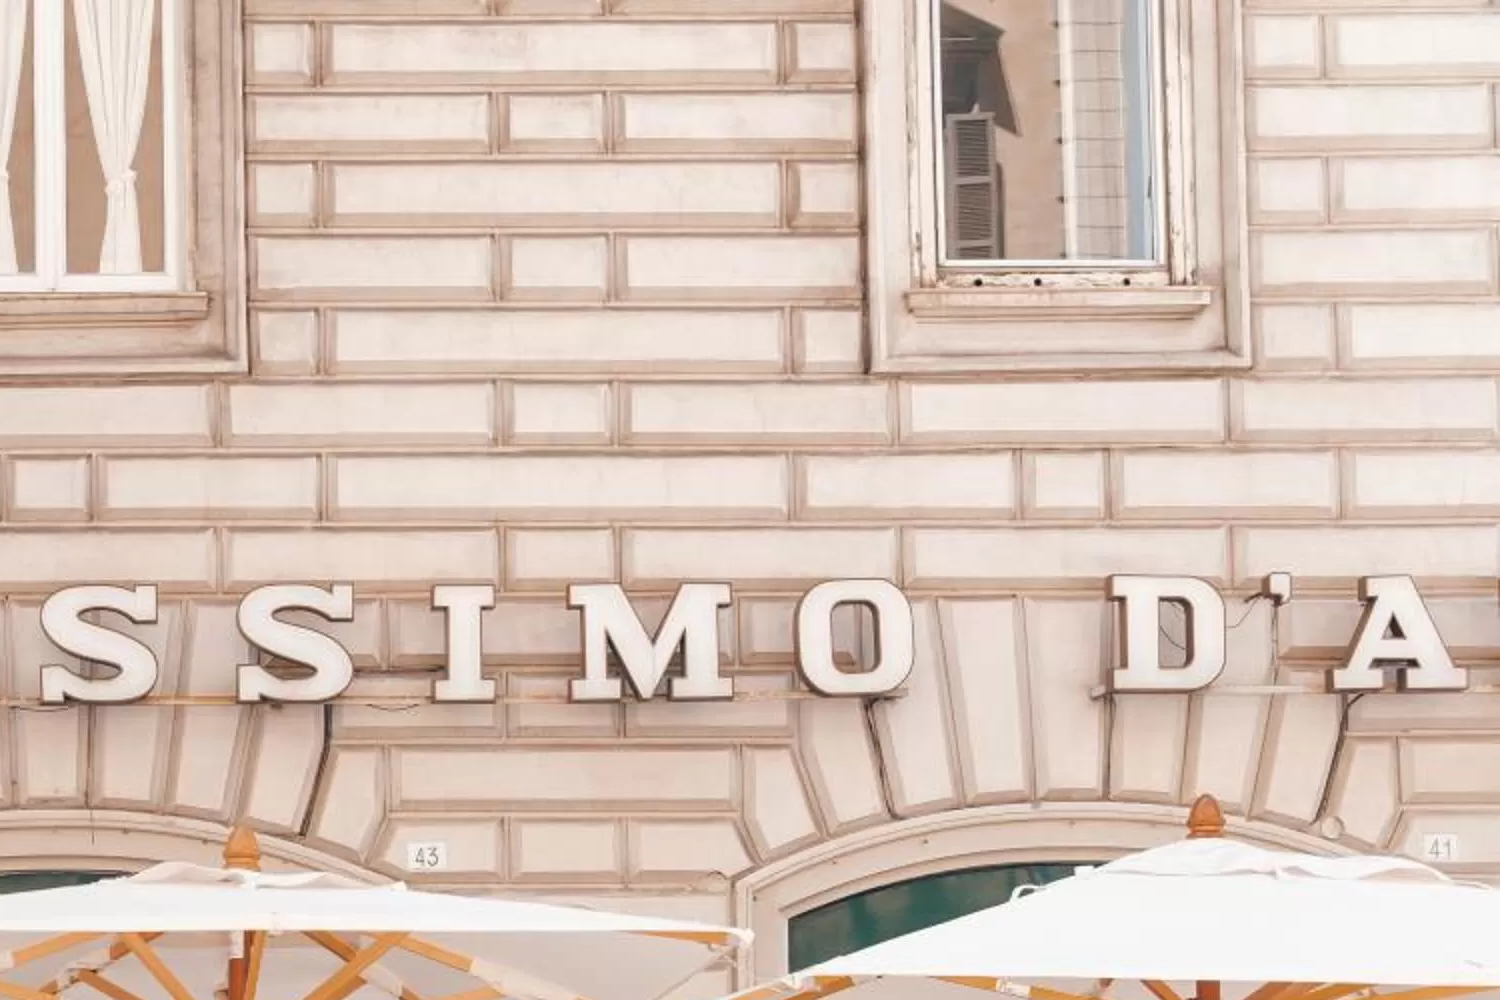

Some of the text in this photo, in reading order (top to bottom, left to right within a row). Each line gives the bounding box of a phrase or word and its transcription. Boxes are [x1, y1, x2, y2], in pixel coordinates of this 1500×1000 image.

[1105, 572, 1469, 693] D'A
[414, 846, 440, 867] 43
[1427, 836, 1453, 859] 41
